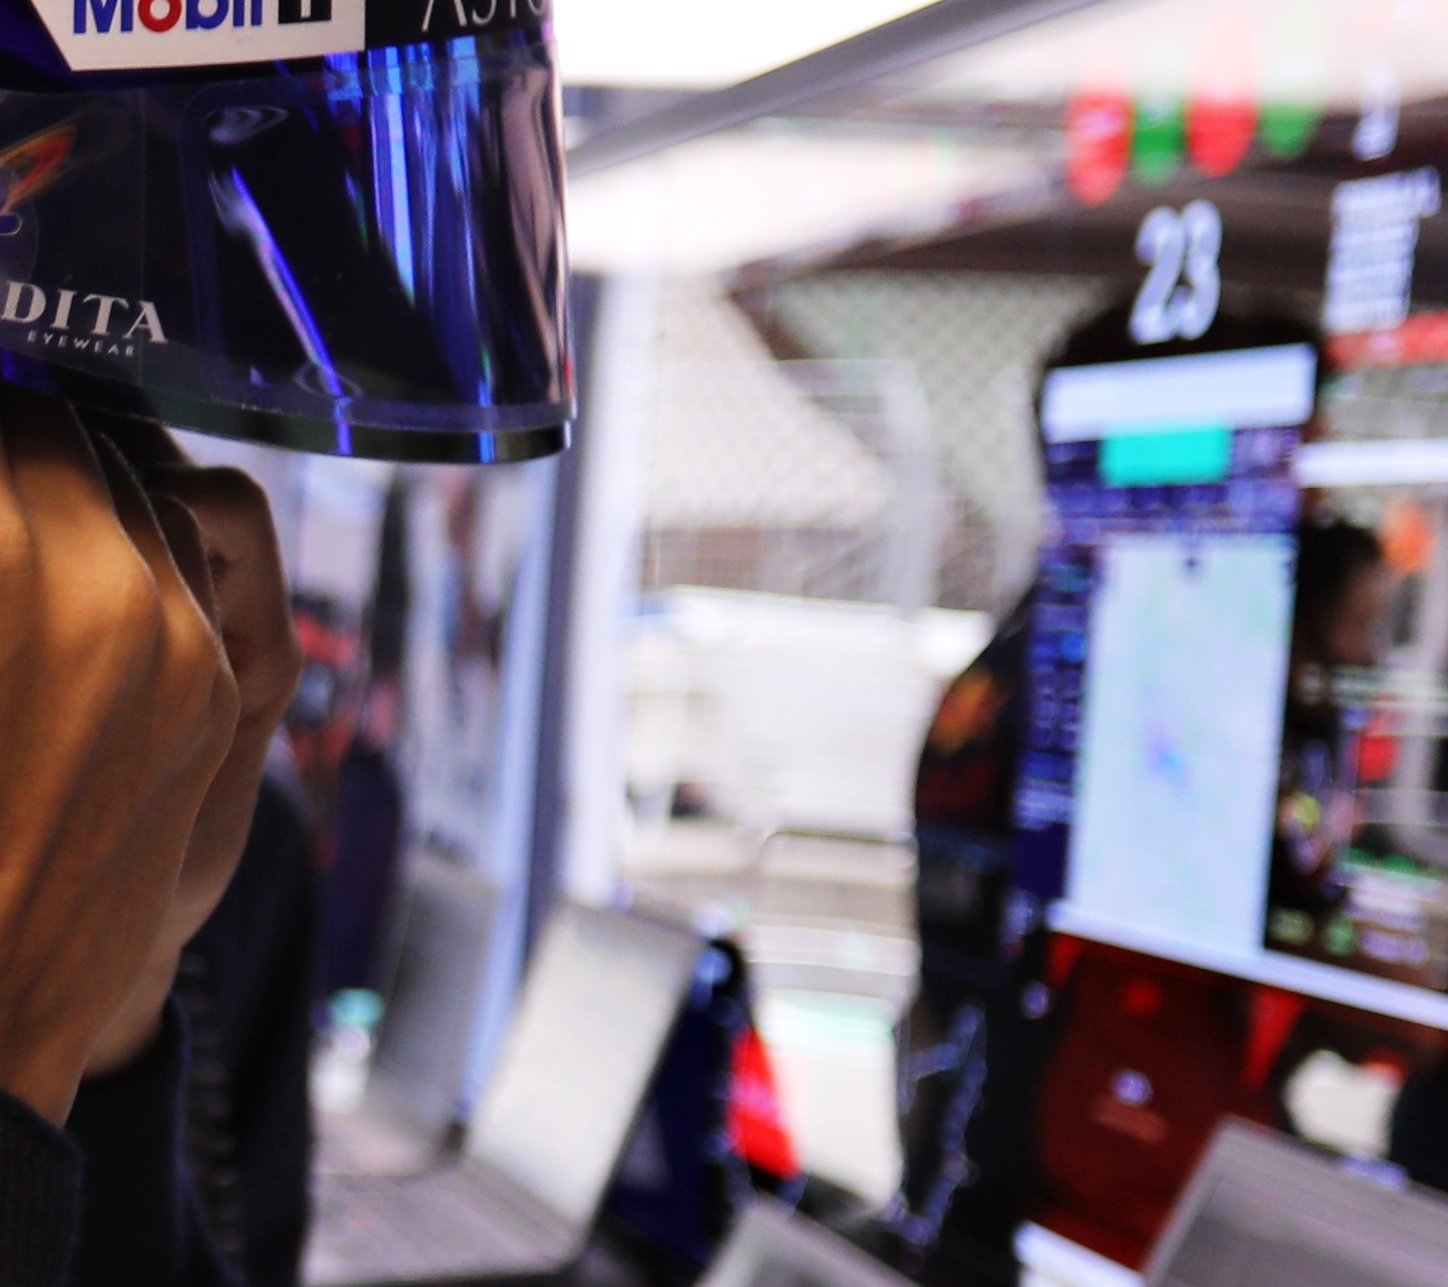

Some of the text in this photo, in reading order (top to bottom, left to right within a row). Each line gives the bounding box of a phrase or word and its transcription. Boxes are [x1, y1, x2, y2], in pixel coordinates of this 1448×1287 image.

[1128, 198, 1222, 345] 23
[0, 279, 169, 344] DITA
[27, 330, 135, 357] EYEWEAR
